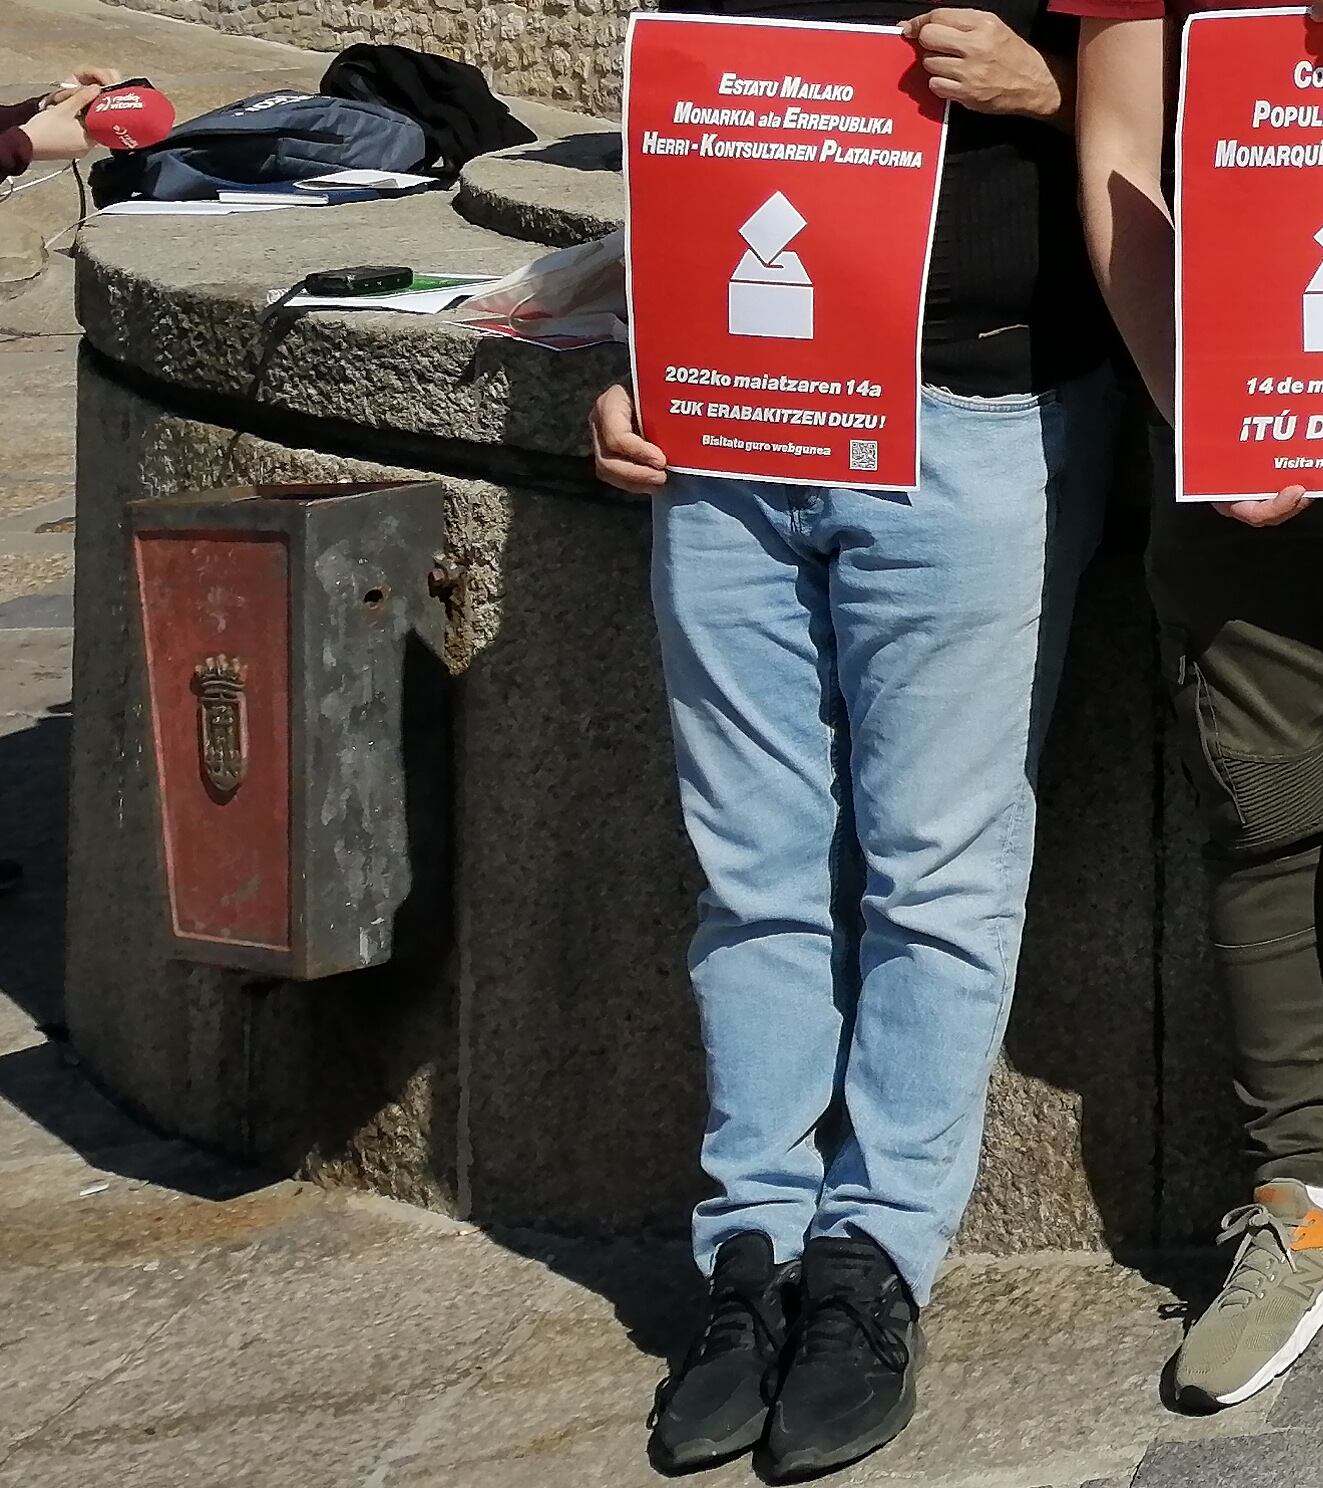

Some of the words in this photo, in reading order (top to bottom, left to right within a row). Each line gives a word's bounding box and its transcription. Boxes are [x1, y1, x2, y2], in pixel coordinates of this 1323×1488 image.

[719, 73, 779, 97] ESTATU
[780, 76, 853, 101] MAILAKO
[674, 101, 754, 126] MONARKIA
[783, 107, 892, 134] ERREPUBLIKA
[819, 139, 922, 168] PLATAFORMA
[666, 367, 731, 386] 2022ko
[733, 374, 841, 394] maiatzaren
[847, 380, 881, 397] 14a
[1247, 378, 1273, 394] 14
[1277, 377, 1304, 394] de
[670, 400, 704, 415] ZUK
[1240, 410, 1297, 441] ¡TÚ
